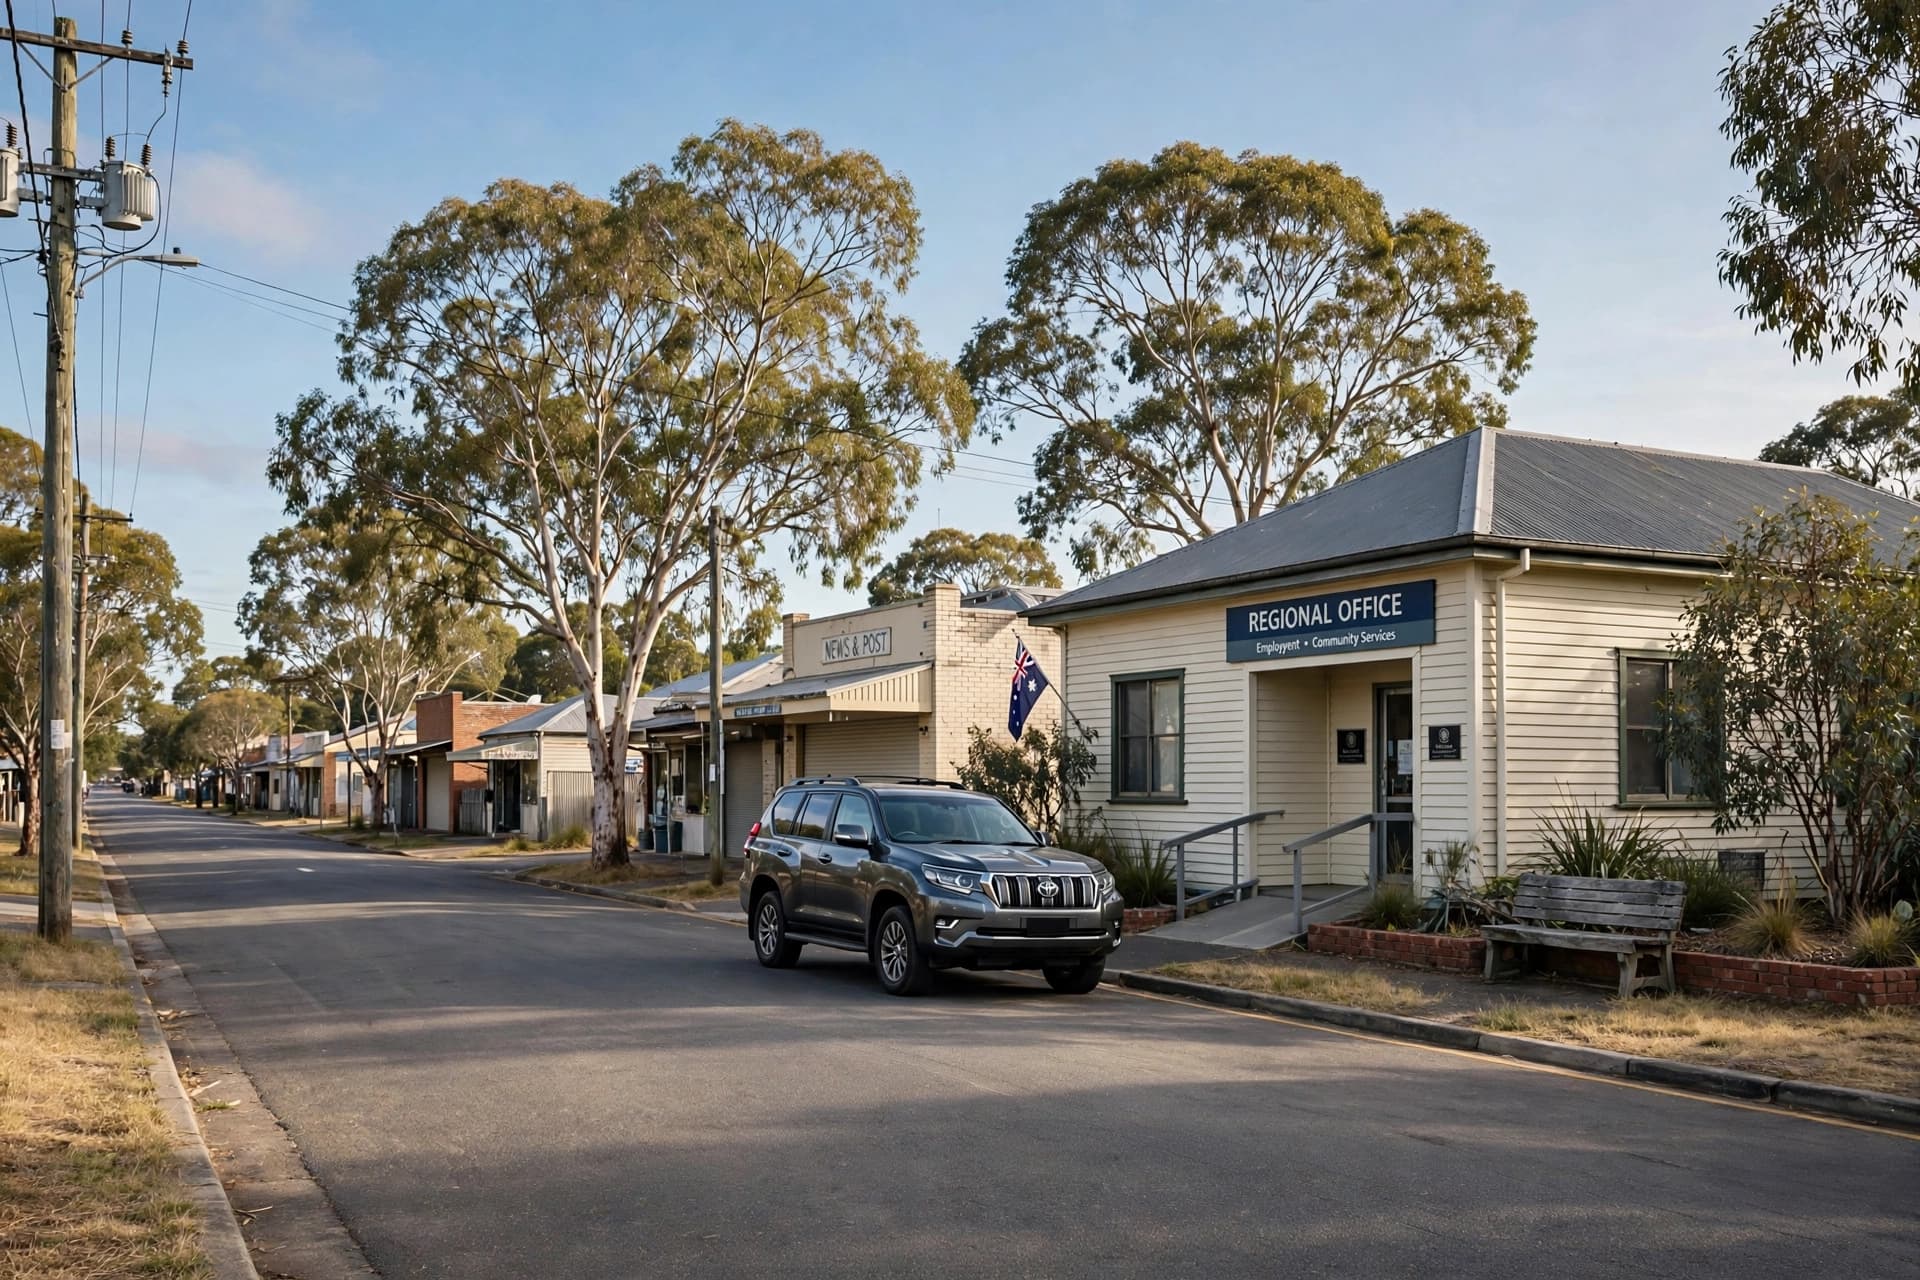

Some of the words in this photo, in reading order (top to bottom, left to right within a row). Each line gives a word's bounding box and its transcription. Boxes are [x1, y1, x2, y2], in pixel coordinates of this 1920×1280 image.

[1249, 603, 1332, 632] REGIONAL
[1338, 593, 1402, 622] OFFICE
[825, 636, 850, 660] NEWS
[852, 635, 859, 657] &
[863, 631, 887, 655] POST
[1312, 634, 1358, 647] Community
[1361, 629, 1396, 643] Services
